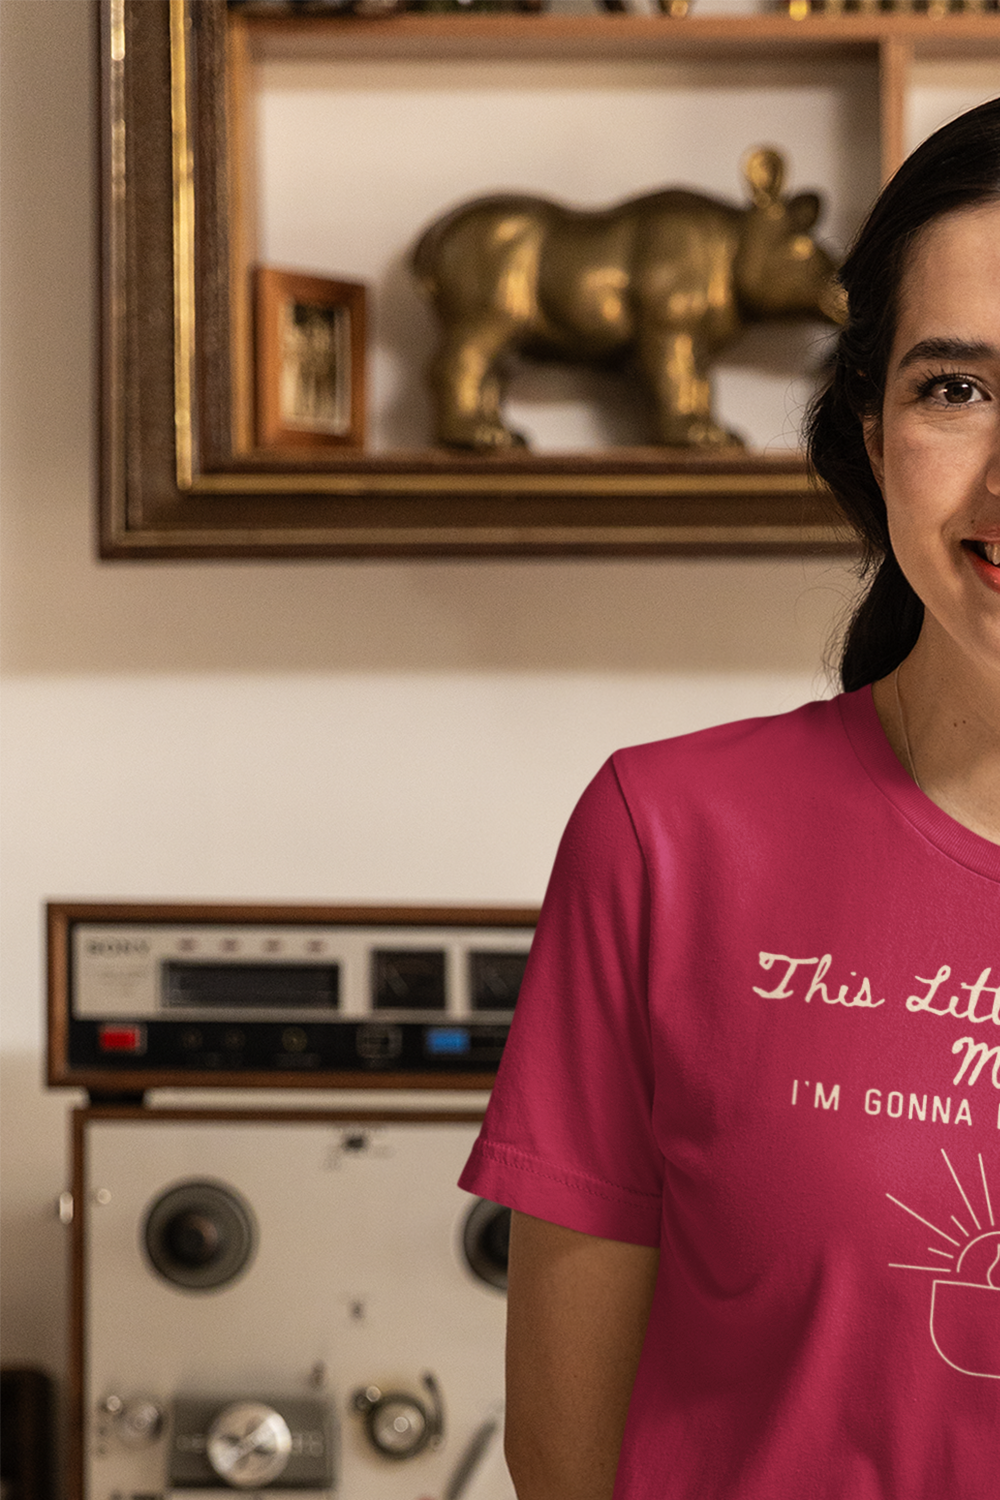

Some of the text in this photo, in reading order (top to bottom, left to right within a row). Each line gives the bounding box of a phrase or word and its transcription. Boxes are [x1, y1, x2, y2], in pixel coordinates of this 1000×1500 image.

[752, 951, 886, 1008] This
[791, 1079, 841, 1111] I'M
[864, 1088, 974, 1127] GONNA
